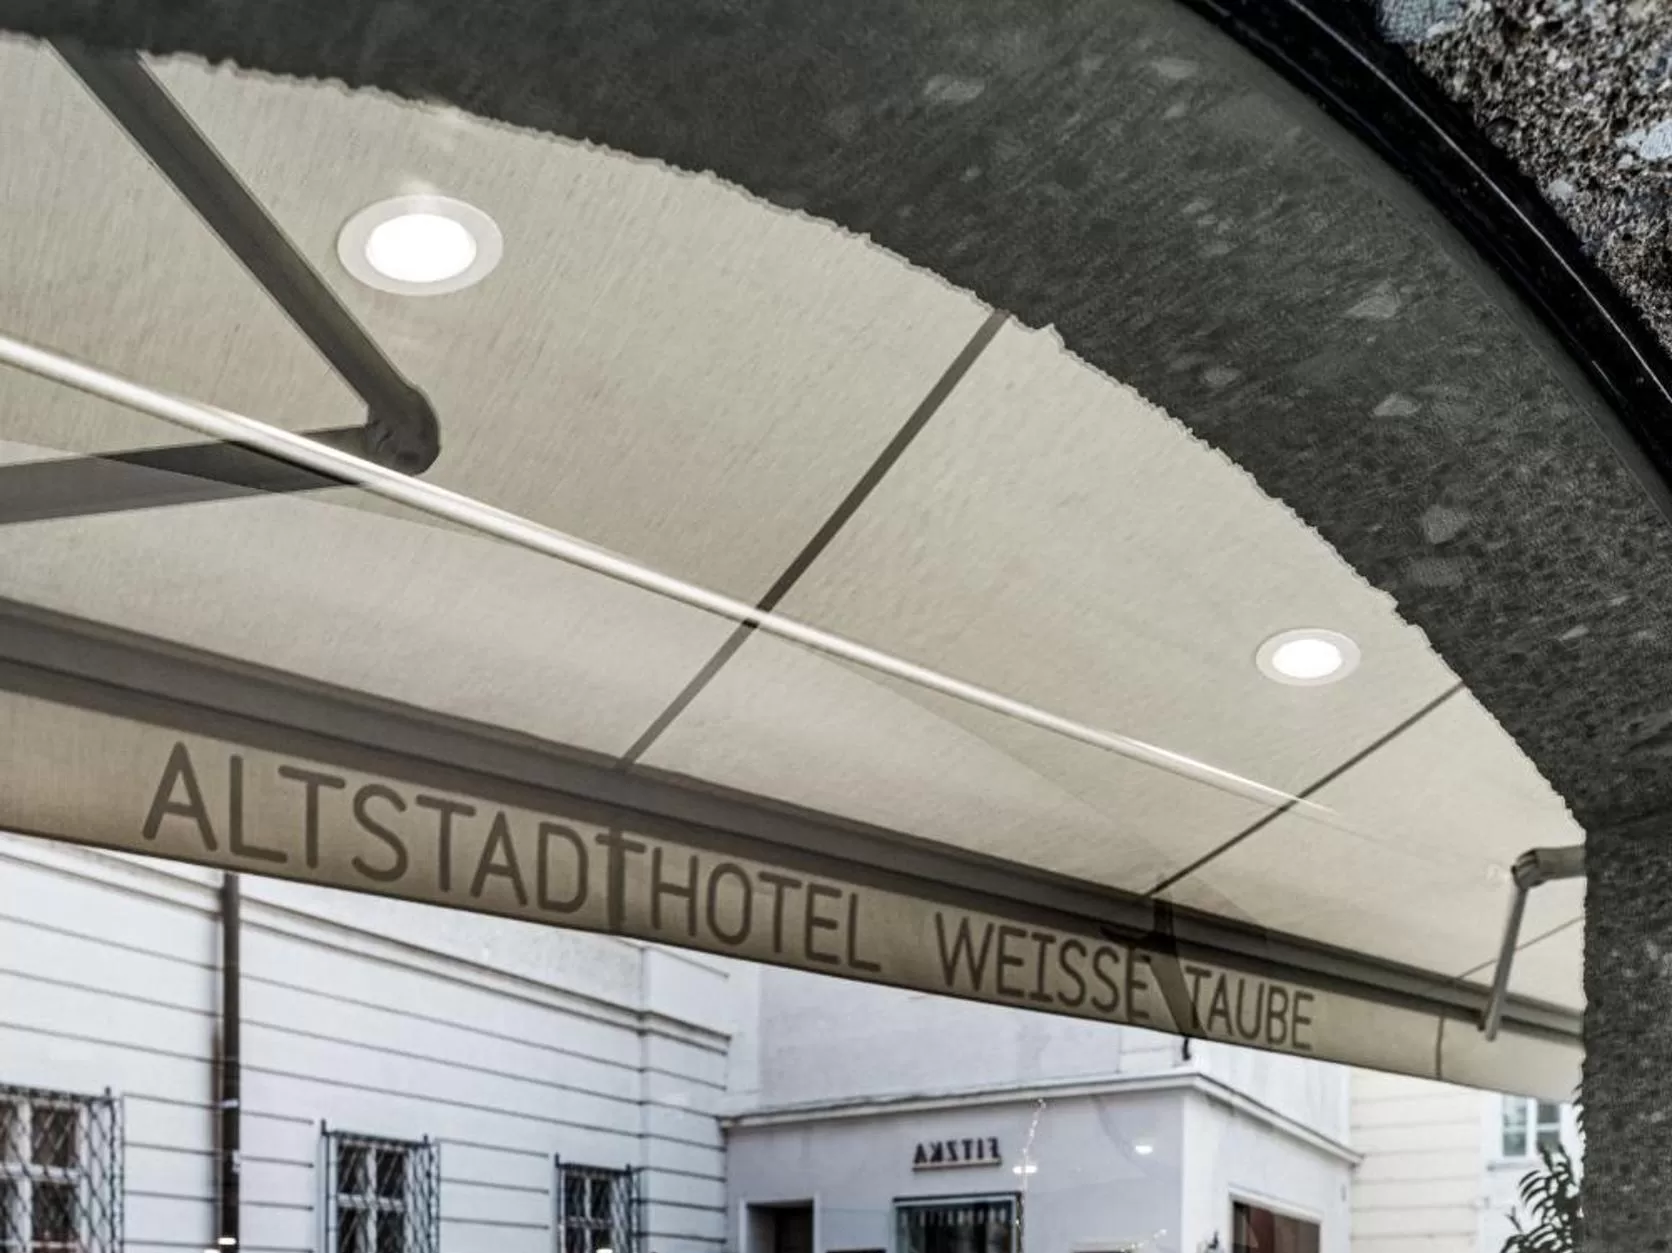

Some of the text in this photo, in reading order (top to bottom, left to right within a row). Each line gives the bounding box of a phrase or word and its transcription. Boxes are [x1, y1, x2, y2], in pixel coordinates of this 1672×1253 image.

[142, 741, 1317, 1052] ALTSTADTHOTEL WEISSE TAUBE
